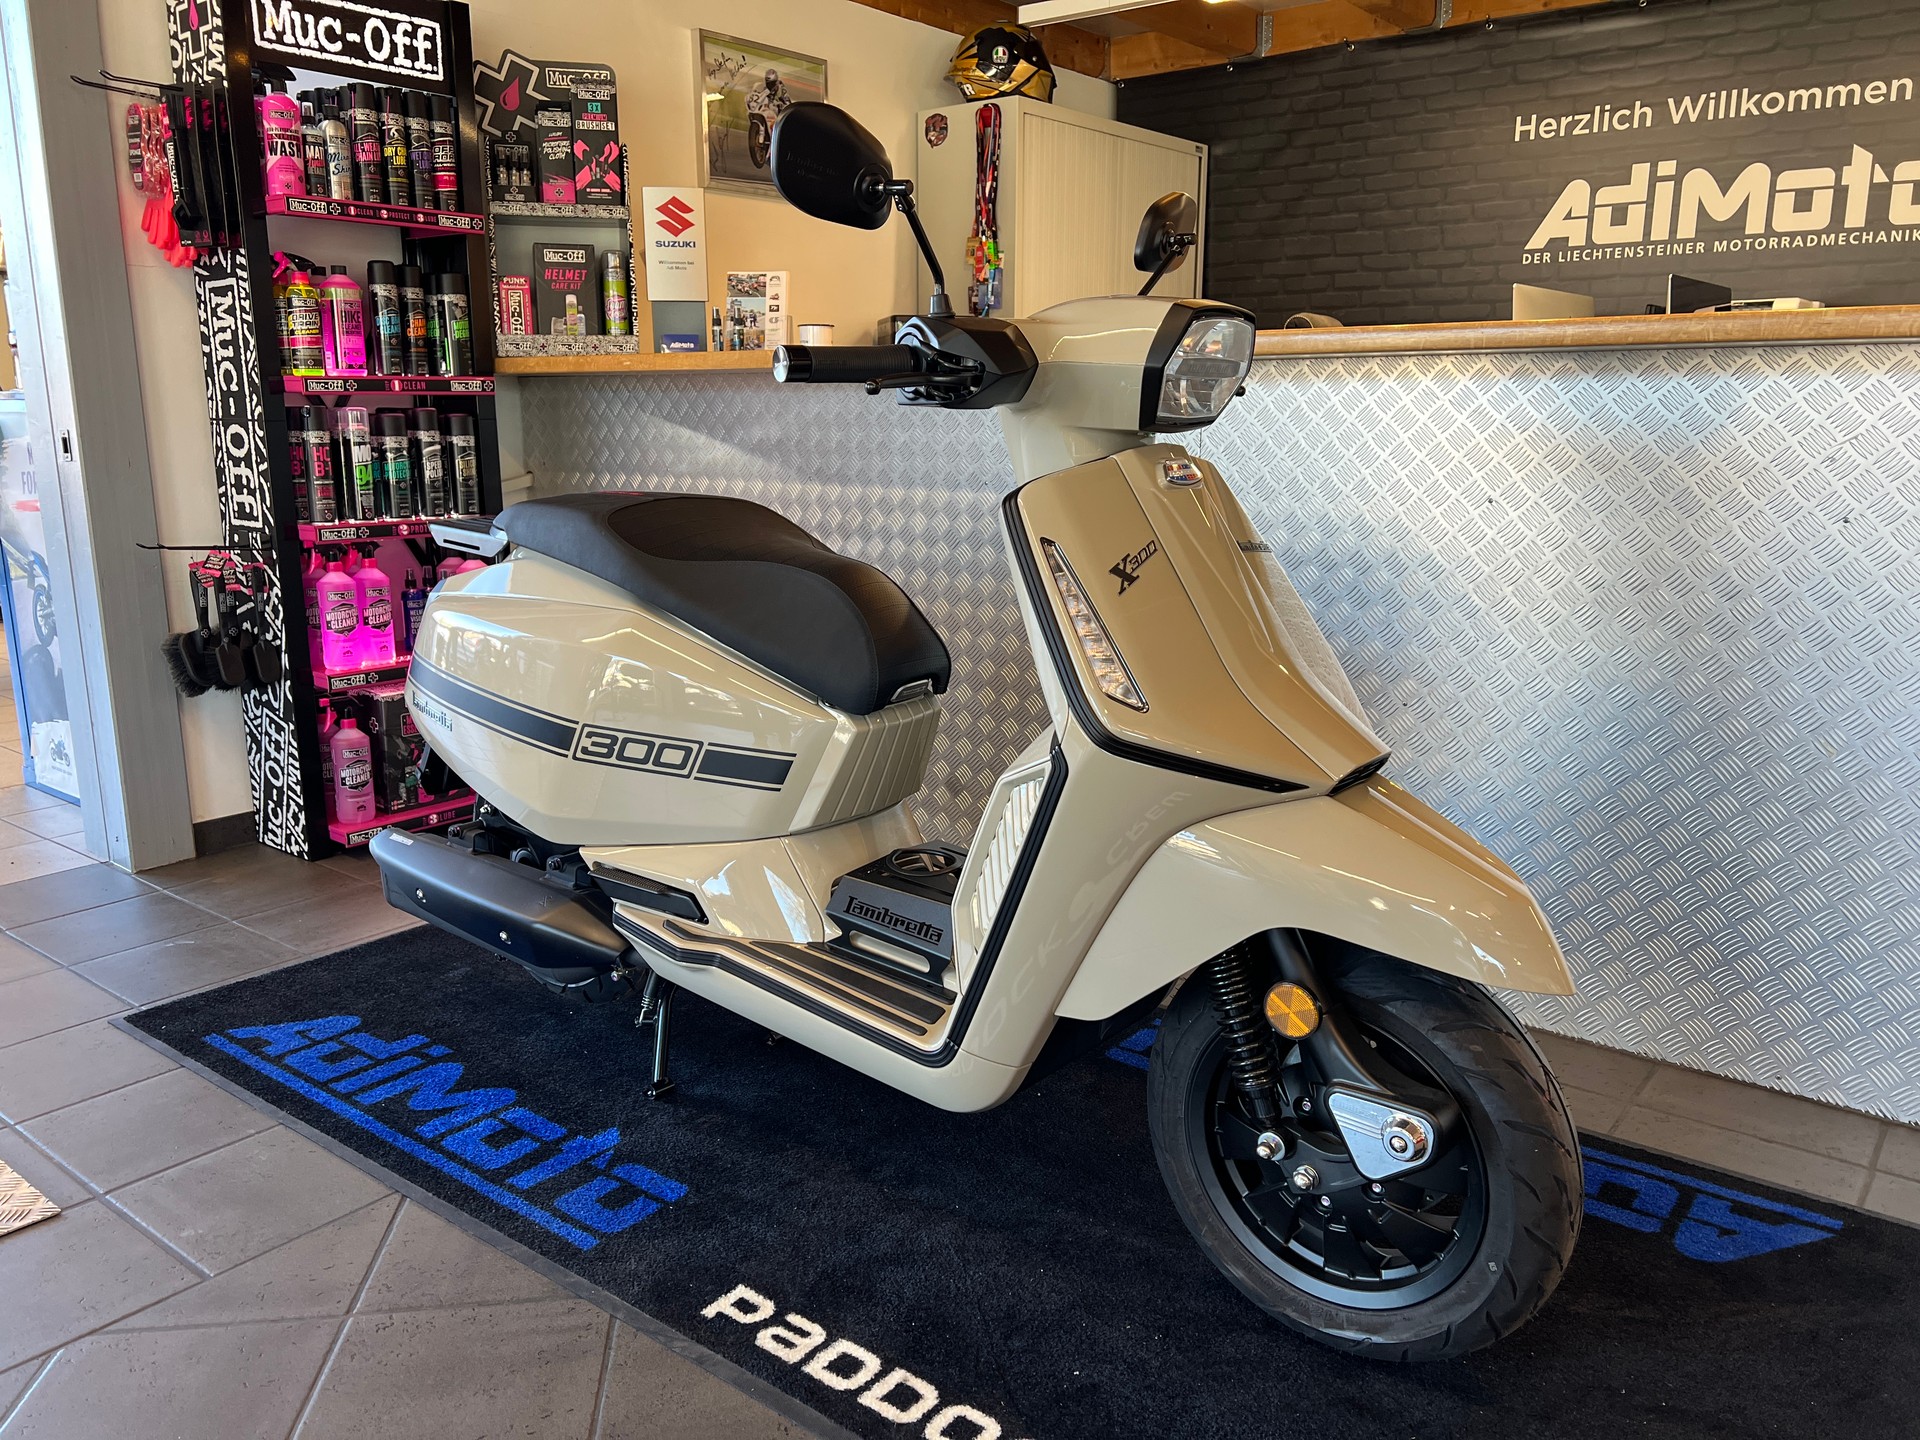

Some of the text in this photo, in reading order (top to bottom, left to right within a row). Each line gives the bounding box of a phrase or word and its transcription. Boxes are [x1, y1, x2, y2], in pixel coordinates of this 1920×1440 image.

[263, 0, 434, 70] Muc-Off
[580, 90, 609, 99] Muc-Off
[1514, 77, 1913, 142] Herzlich Willkommen
[577, 121, 614, 130] BRUSH SET
[291, 200, 325, 213] Muc-Off
[357, 207, 374, 216] CLEAN
[440, 216, 470, 228] Muc-Off
[655, 240, 696, 248] SUZUKI
[1522, 229, 1920, 265] DER LIECHTENSTEINER MOTORRADMECHANIK
[546, 251, 584, 261] Muc-Off
[544, 268, 587, 281] HELMET
[551, 282, 582, 290] CARE KIT
[292, 313, 319, 321] DRIVE
[511, 292, 523, 335] Muc-Off
[292, 320, 319, 329] TRAIN
[310, 381, 343, 391] Muc-Off
[404, 381, 426, 390] CLEAN
[452, 382, 482, 391] Muc-Off
[210, 291, 258, 516] Muc-Off
[356, 465, 373, 485] 94
[323, 529, 356, 540] Muc-Off
[328, 592, 355, 601] Muc-Off
[333, 675, 366, 689] Muc-Off
[581, 731, 694, 771] 300
[843, 895, 944, 946] Lambretta
[227, 1015, 690, 1234] AdiMoto
